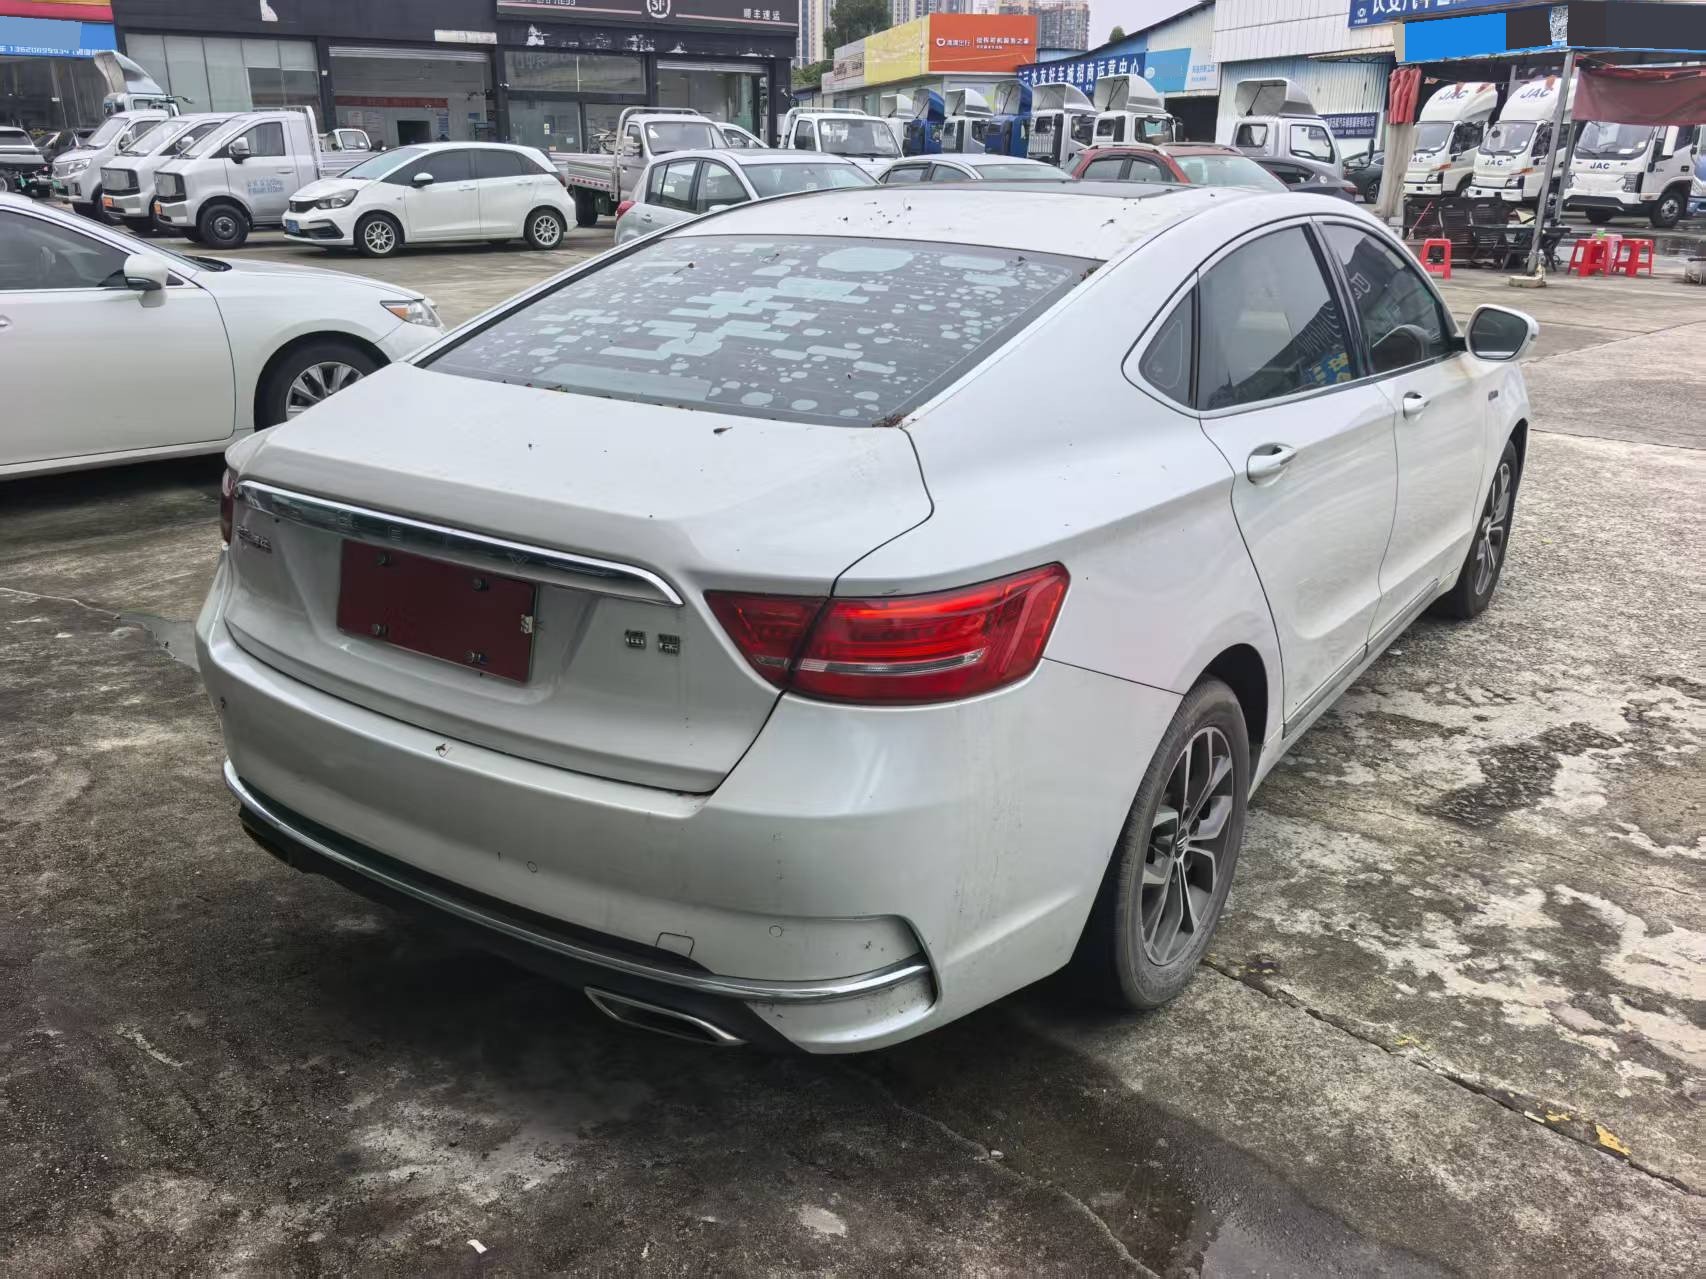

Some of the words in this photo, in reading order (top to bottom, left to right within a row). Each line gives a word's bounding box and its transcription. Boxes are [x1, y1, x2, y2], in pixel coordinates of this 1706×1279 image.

[743, 8, 781, 21] 顺丰速运
[1519, 87, 1550, 100] JAC
[1484, 159, 1503, 167] JAC
[1590, 161, 1611, 170] JAC
